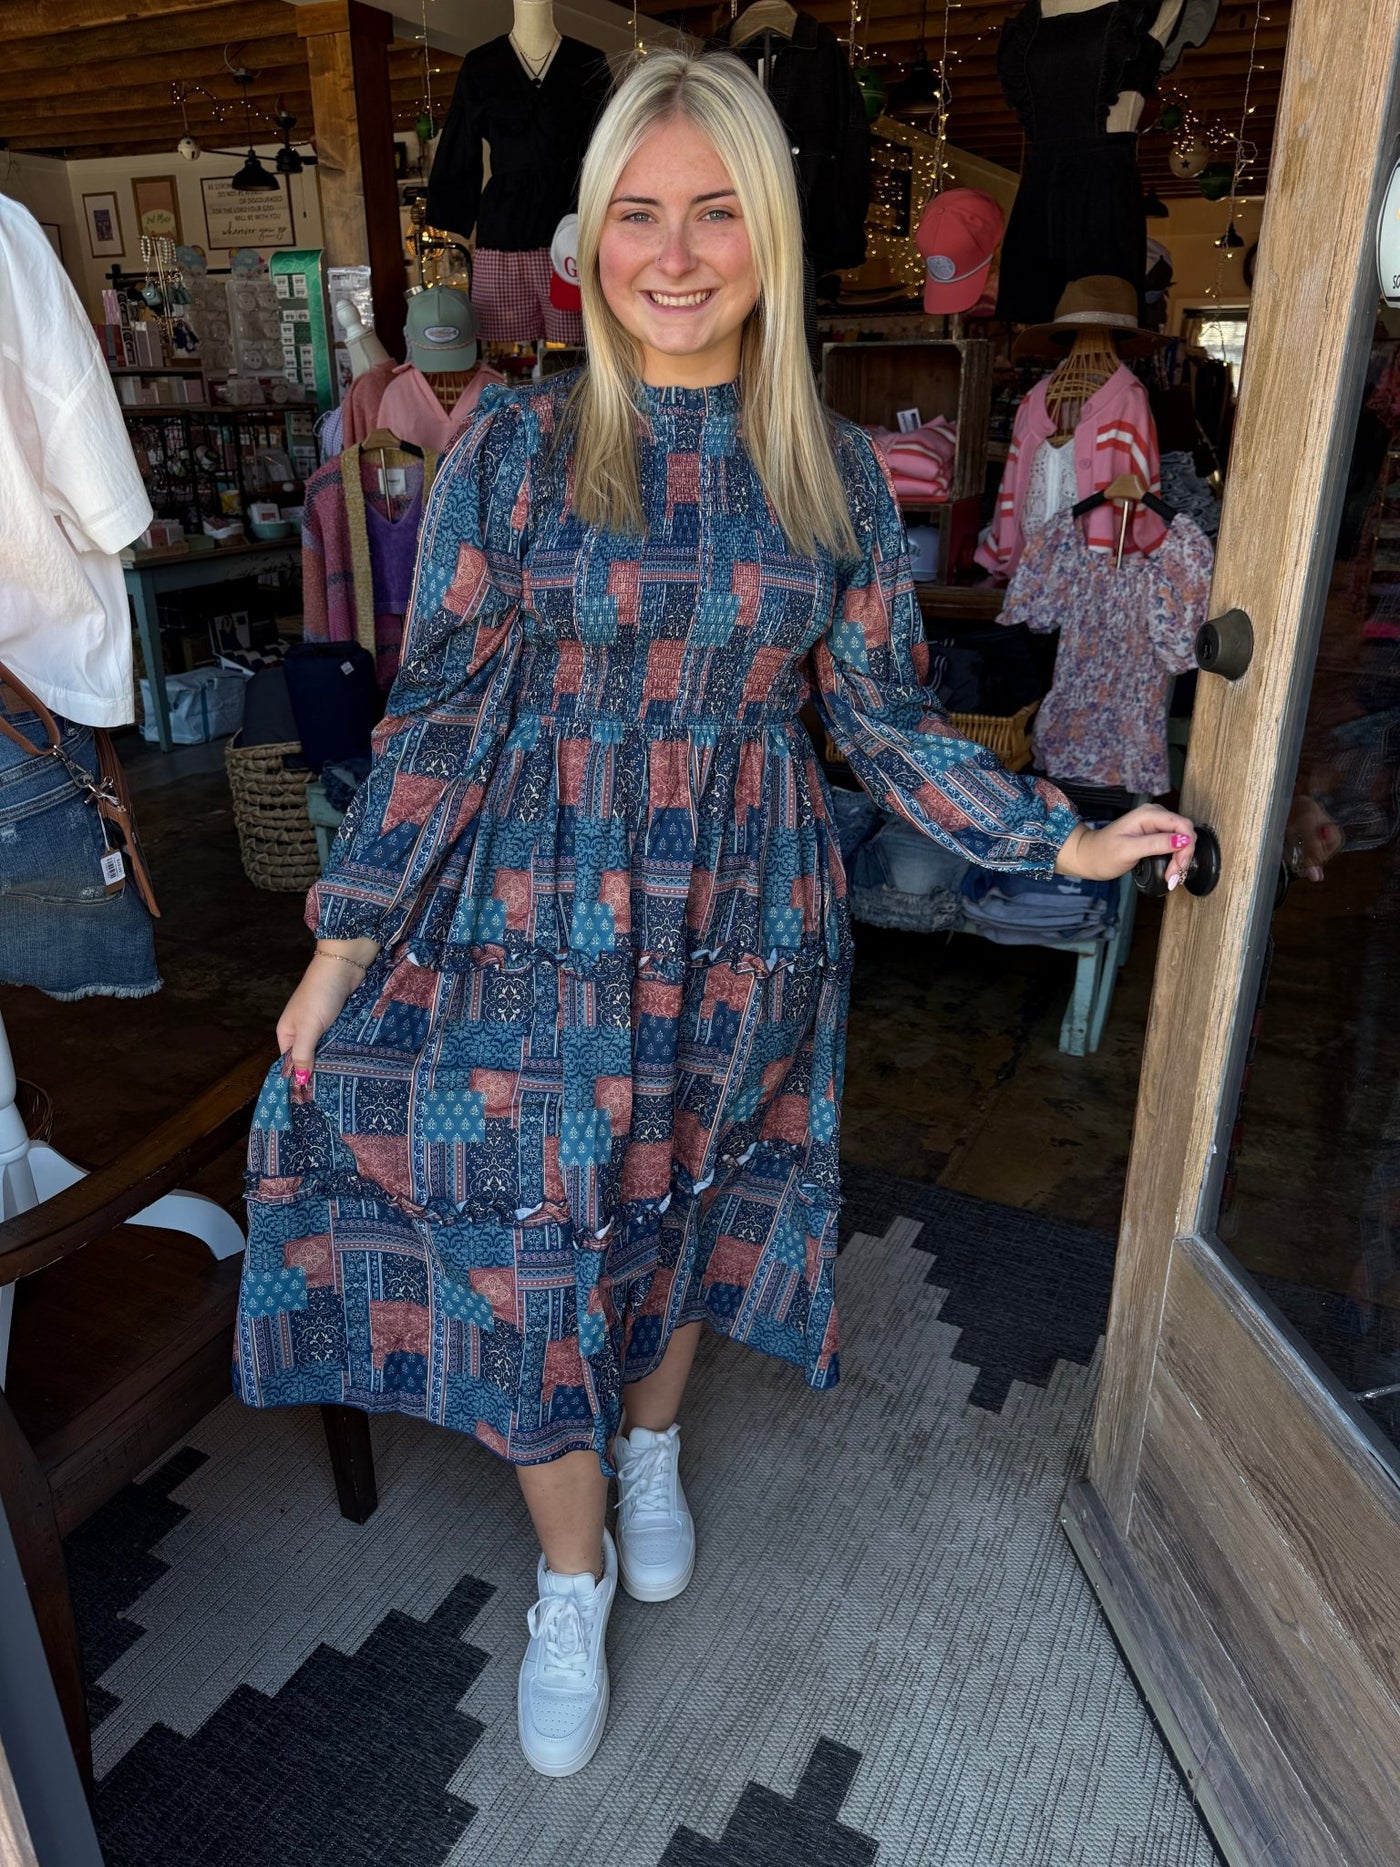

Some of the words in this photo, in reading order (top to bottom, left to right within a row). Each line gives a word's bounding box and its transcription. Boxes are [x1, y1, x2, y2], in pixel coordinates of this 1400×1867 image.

[247, 195, 283, 204] DISCOURAGED
[222, 220, 255, 236] wherever
[258, 227, 275, 242] you
